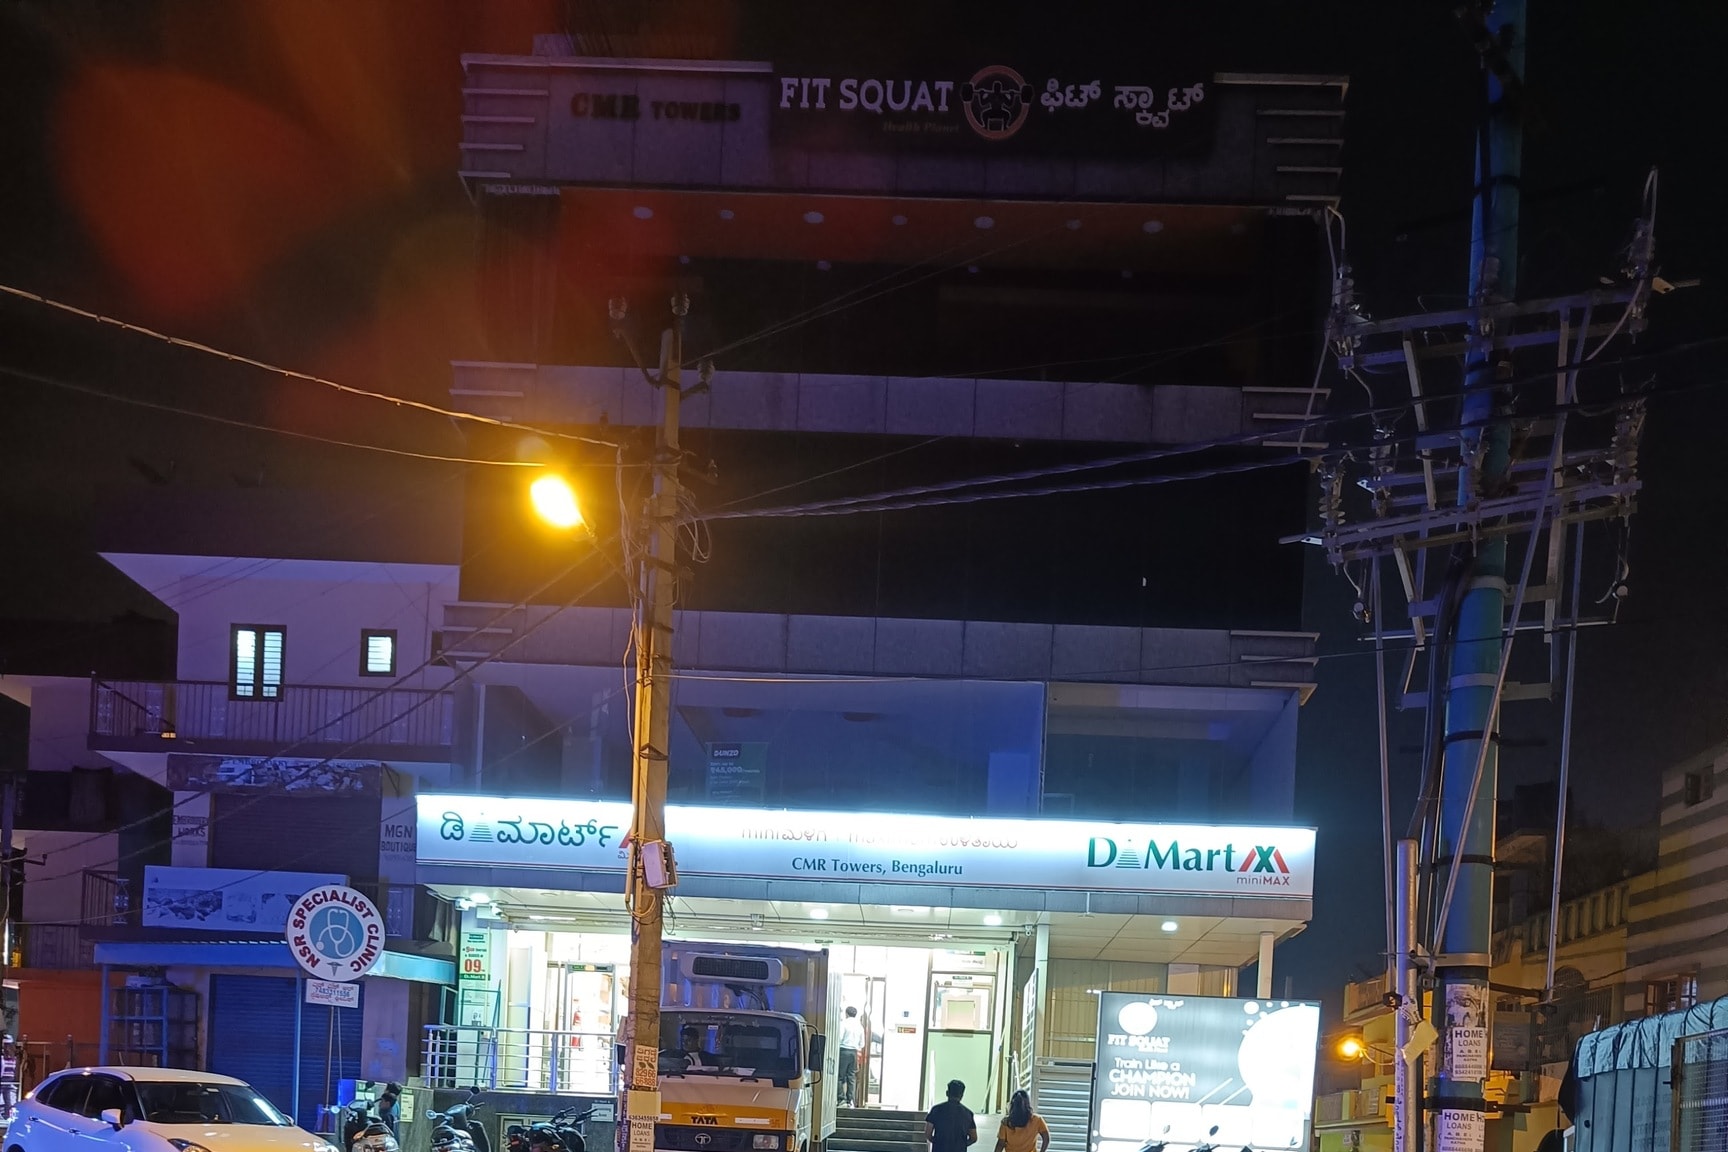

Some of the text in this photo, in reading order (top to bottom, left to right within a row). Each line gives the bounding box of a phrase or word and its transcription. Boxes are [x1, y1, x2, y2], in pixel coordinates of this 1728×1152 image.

[779, 77, 954, 114] FIT SQUAT
[384, 824, 413, 839] MGN
[791, 856, 963, 878] CMR Towers, Bengaluru
[1236, 875, 1290, 886] miniMAX
[292, 889, 379, 973] NSR SPECIALIST CLINIC
[1107, 1033, 1128, 1046] FIT
[1455, 1030, 1483, 1038] HOME
[1458, 1039, 1481, 1047] LOANS
[1114, 1056, 1143, 1070] Train
[1144, 1058, 1169, 1071] Like
[1108, 1069, 1197, 1087] CHAMPION
[1111, 1084, 1190, 1099] JOIN NOW!
[691, 1115, 718, 1125] TATA
[1444, 1112, 1475, 1122] HOME
[632, 1122, 652, 1130] HOME
[1446, 1122, 1472, 1130] LOANS
